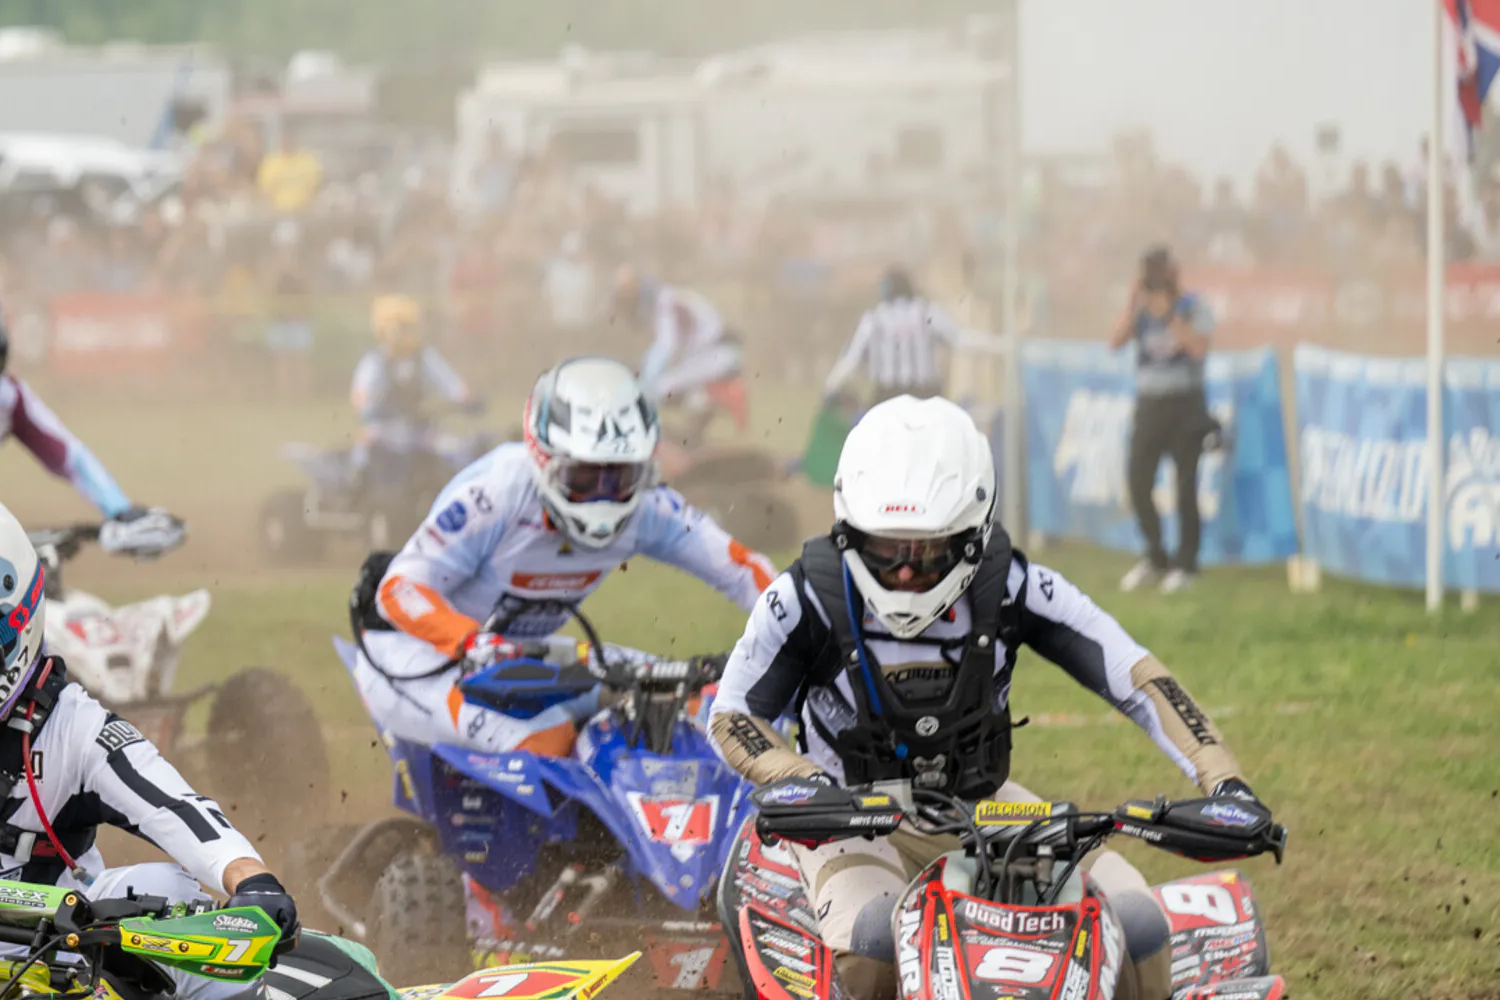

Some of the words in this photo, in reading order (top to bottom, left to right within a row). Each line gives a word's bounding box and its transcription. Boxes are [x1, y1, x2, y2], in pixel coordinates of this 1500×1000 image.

[965, 901, 1015, 932] Quad
[1016, 911, 1066, 933] Tech
[1161, 884, 1239, 925] 8
[223, 939, 251, 962] 7
[670, 946, 715, 989] 1
[975, 946, 1054, 984] 8
[476, 972, 529, 999] 7
